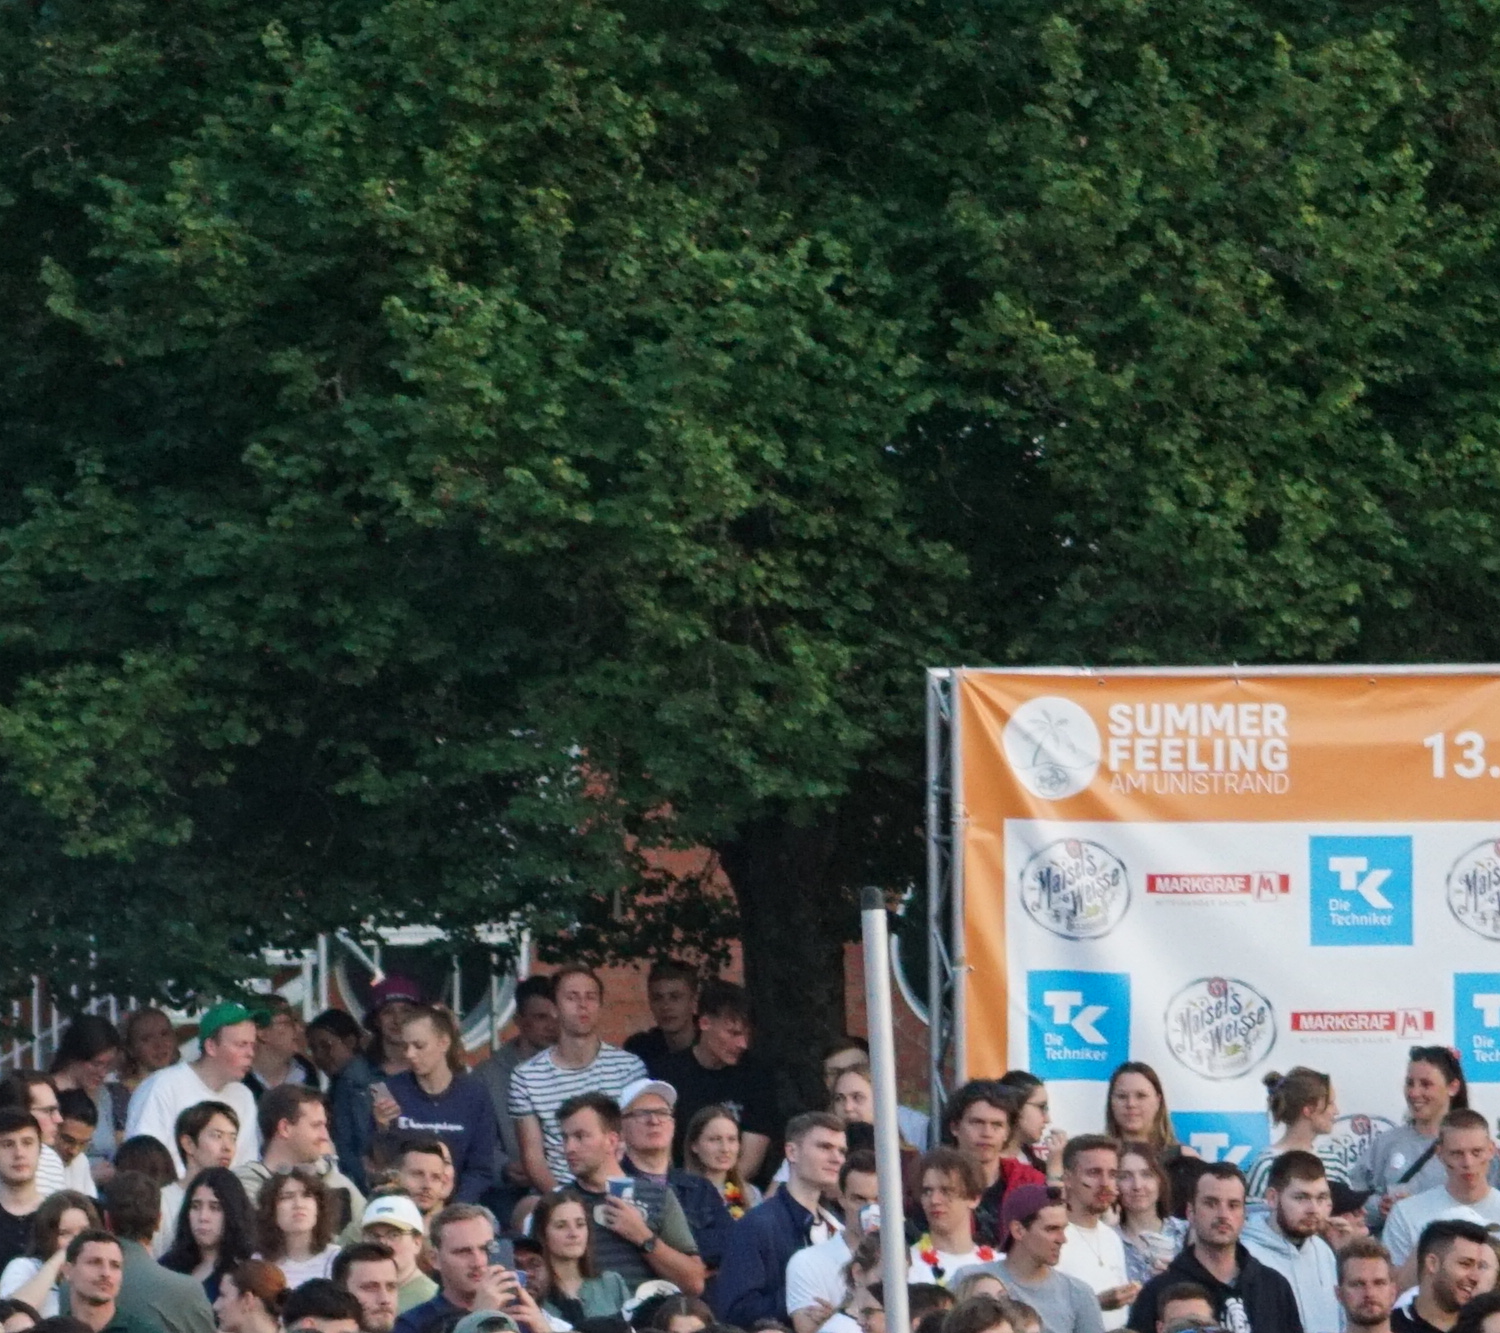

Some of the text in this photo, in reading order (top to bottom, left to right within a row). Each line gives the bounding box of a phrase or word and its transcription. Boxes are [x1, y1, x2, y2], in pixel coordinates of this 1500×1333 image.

[1108, 703, 1290, 737] SUMMER
[1108, 738, 1289, 772] FEELING
[1109, 772, 1290, 794] AM UNISTRAND
[1154, 876, 1246, 893] MARKGRAF
[1328, 856, 1393, 909] TK
[1329, 898, 1351, 912] Die
[1329, 913, 1393, 926] Techniker
[1043, 991, 1109, 1045] TK
[1300, 1012, 1391, 1031] MARKGRAF
[1044, 1032, 1064, 1046] Die
[1473, 1035, 1495, 1049] Die
[1044, 1048, 1109, 1061] Techniker
[397, 1115, 464, 1133] Champion
